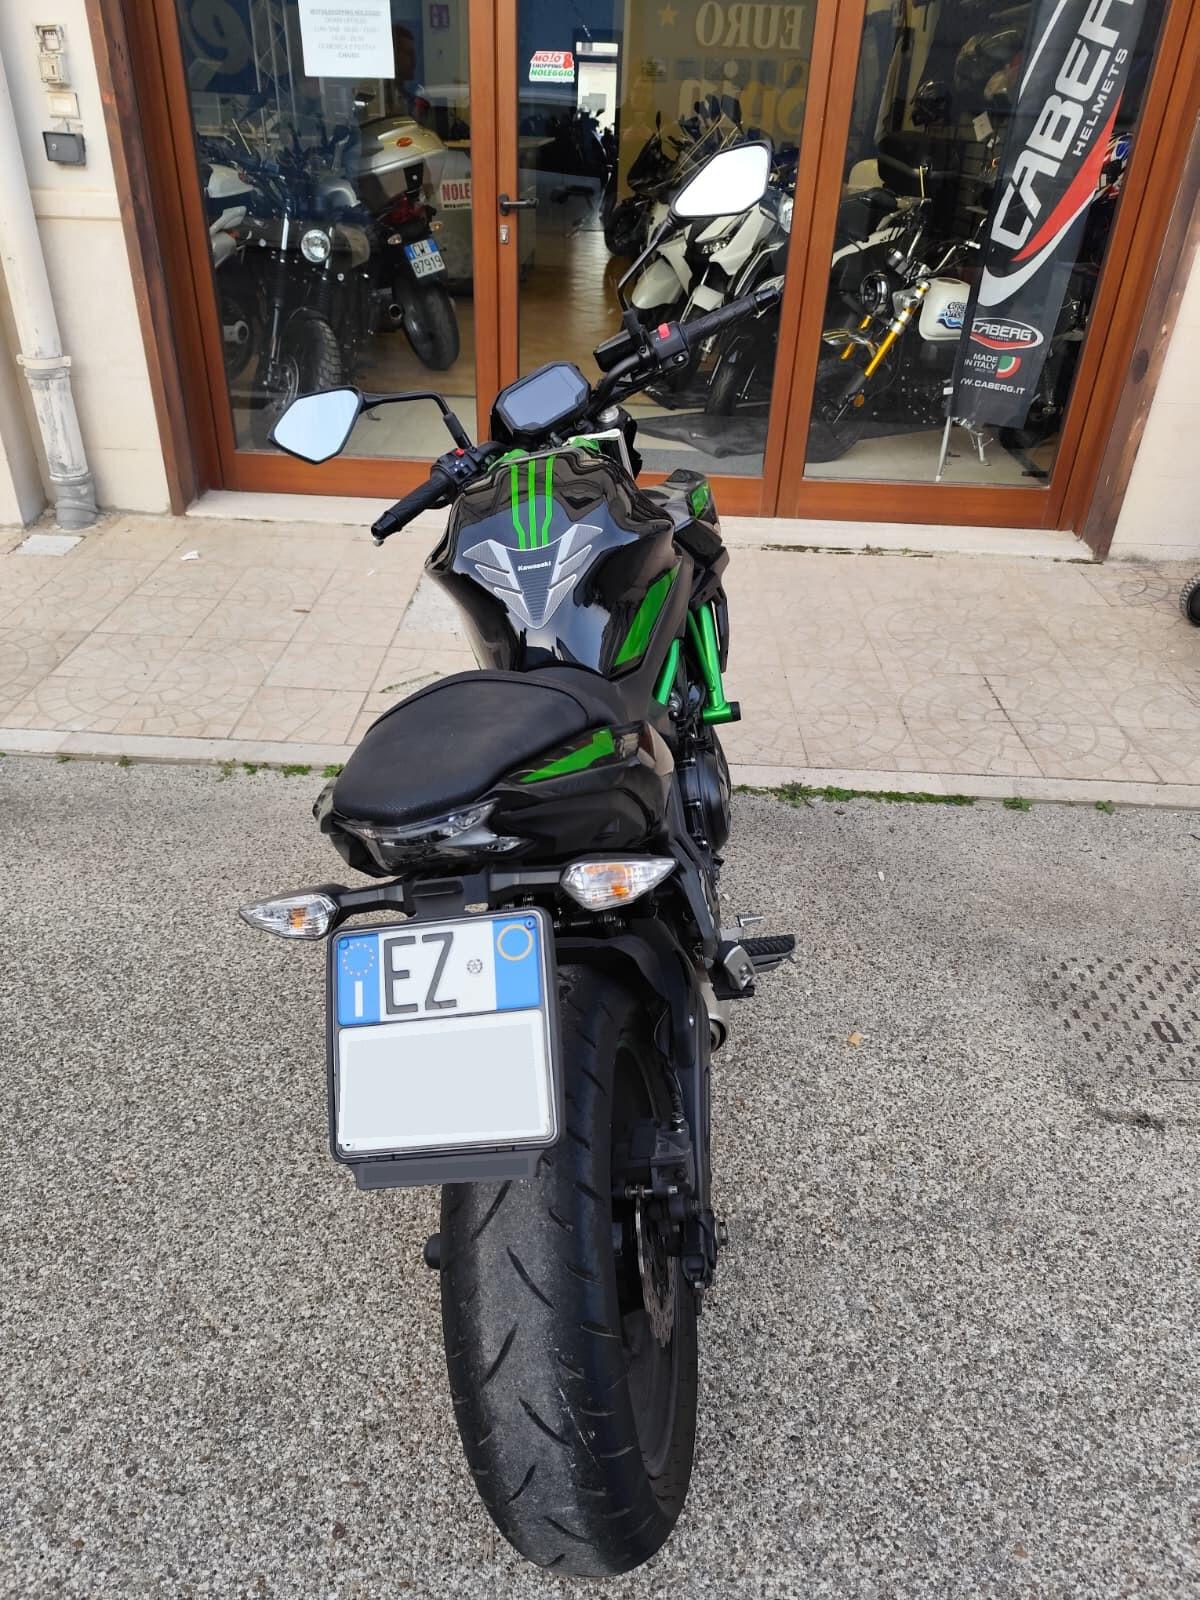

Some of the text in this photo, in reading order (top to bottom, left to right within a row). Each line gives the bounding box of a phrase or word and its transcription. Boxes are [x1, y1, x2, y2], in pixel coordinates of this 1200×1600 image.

[531, 69, 573, 77] NOLEGGIO
[1073, 47, 1129, 157] HELMETS
[413, 255, 443, 274] 87919
[971, 321, 1033, 341] CABERG
[973, 353, 999, 363] MADE
[973, 360, 997, 370] ITALY
[517, 560, 552, 572] Kawasaki
[383, 931, 457, 1015] EZ
